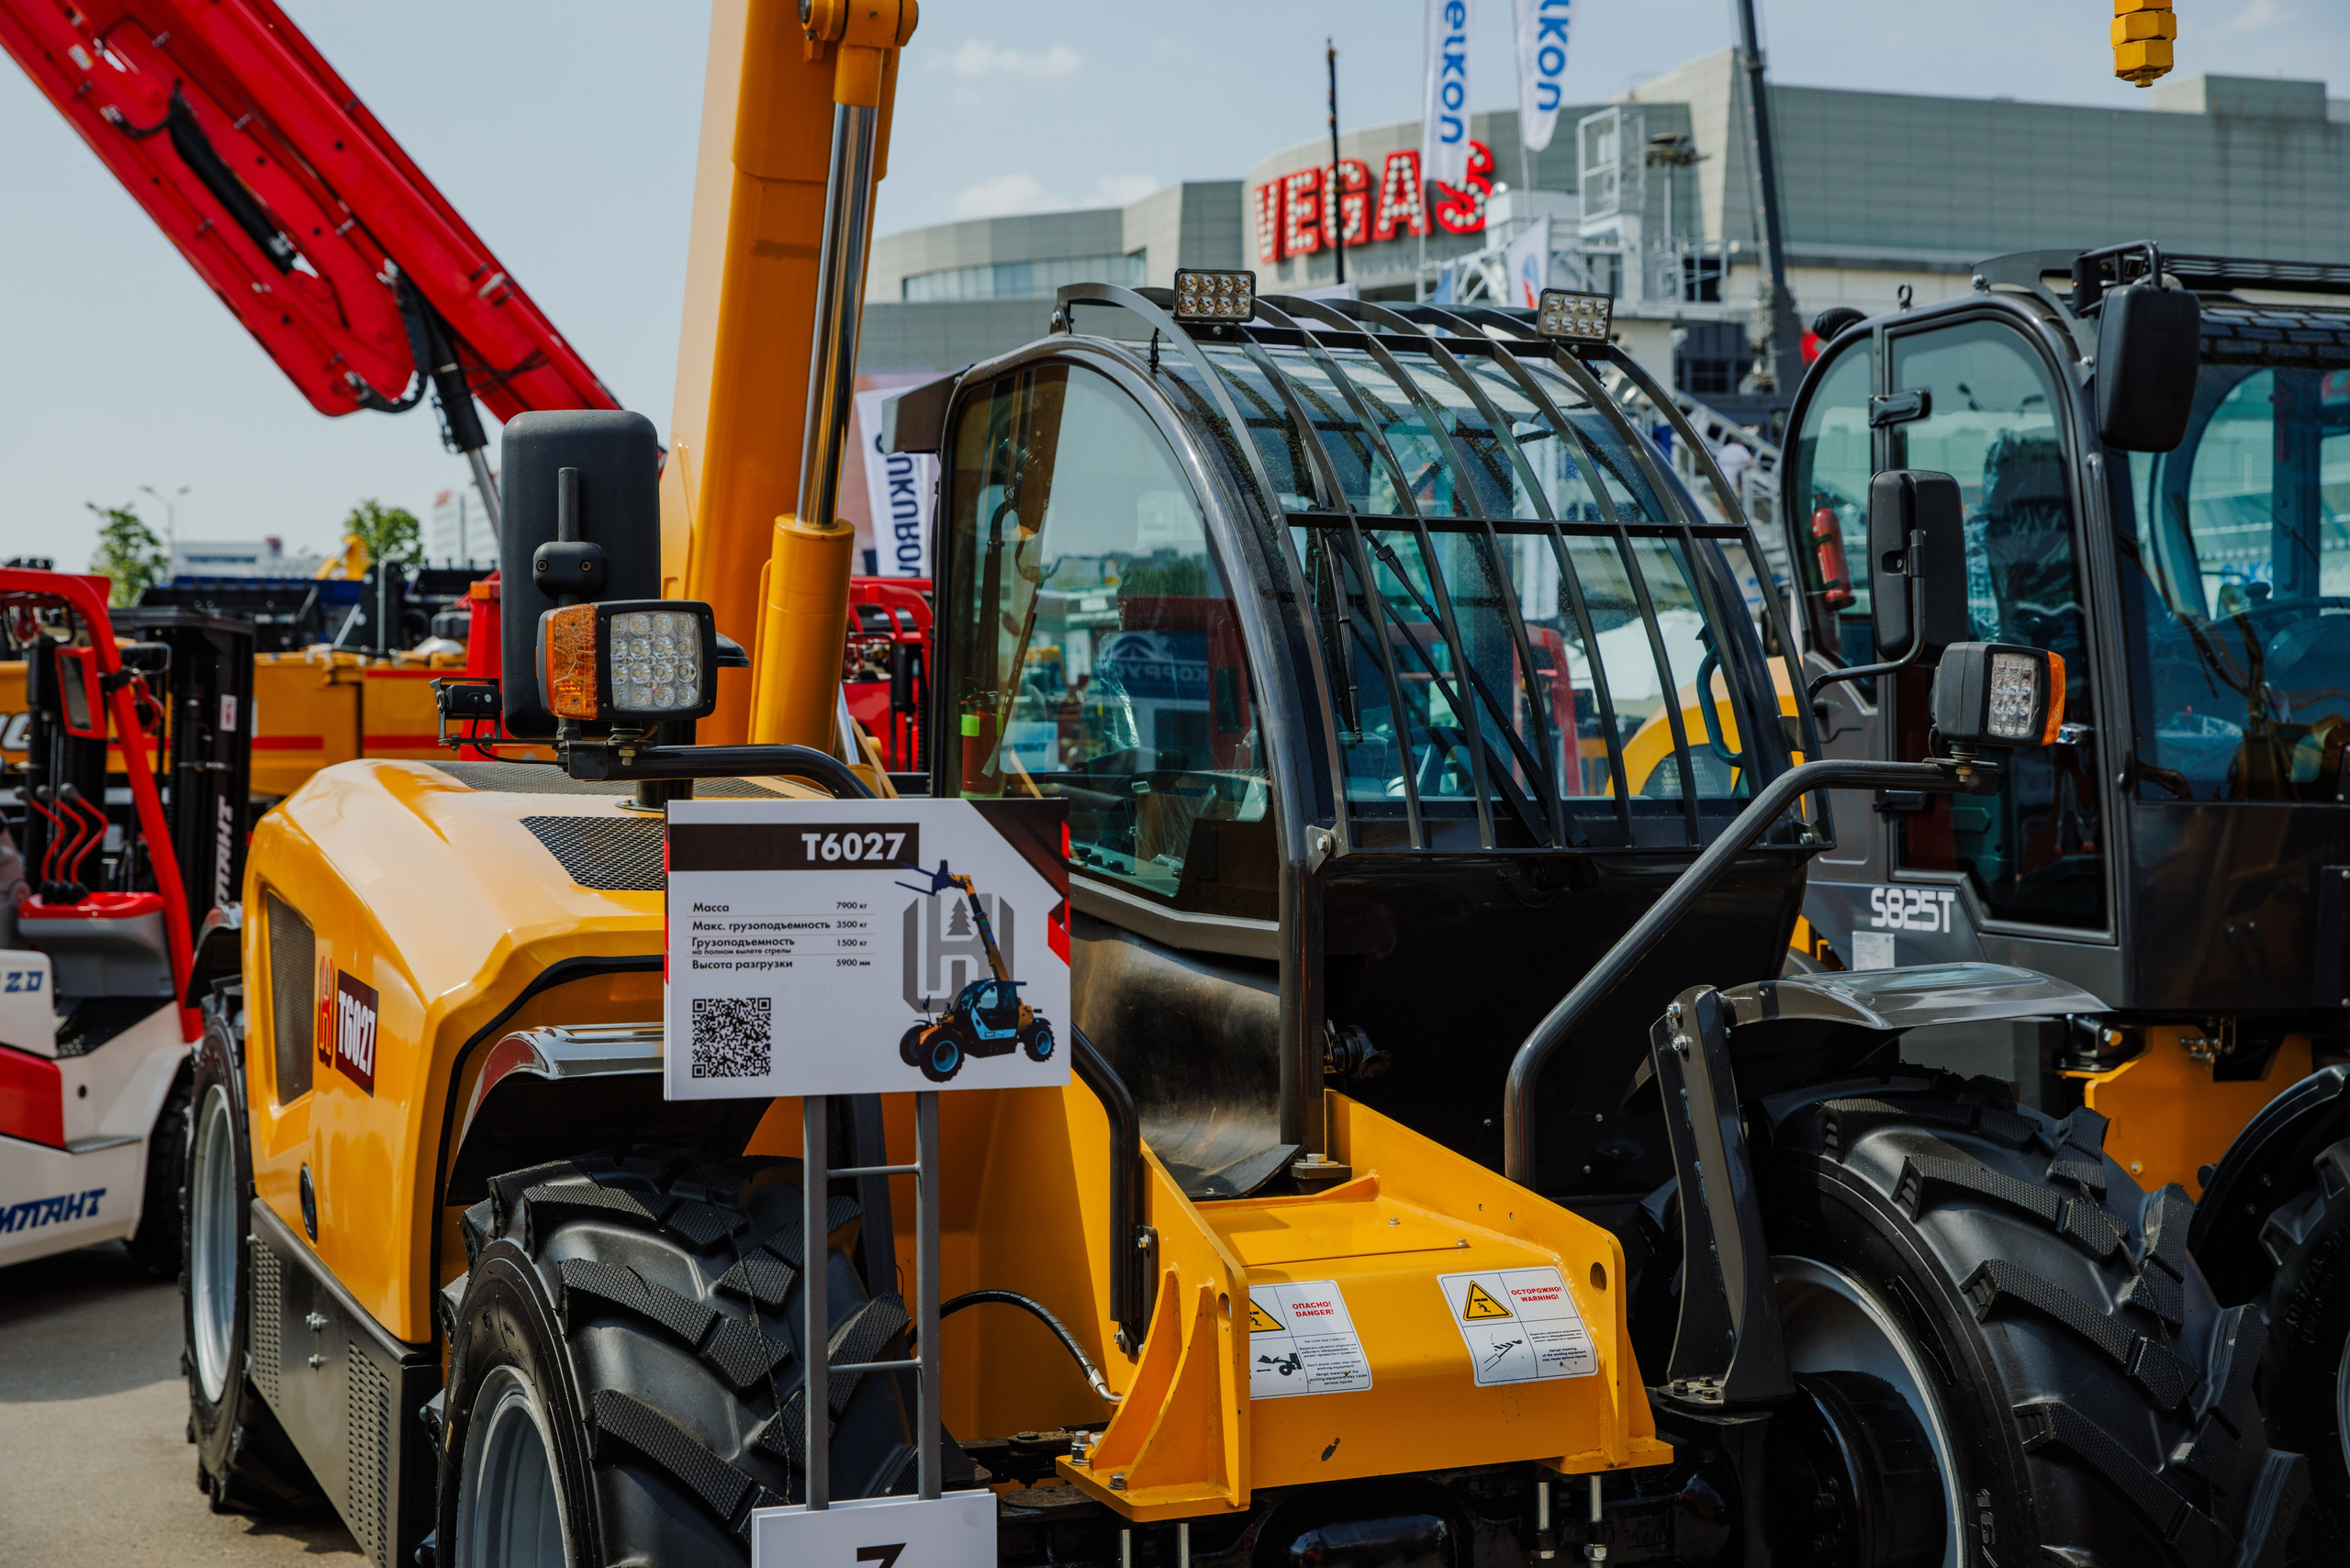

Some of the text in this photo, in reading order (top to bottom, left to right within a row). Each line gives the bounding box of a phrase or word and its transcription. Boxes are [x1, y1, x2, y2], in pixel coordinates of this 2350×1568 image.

[1254, 140, 1493, 263] VEGAS
[801, 832, 907, 861] T6027
[693, 902, 730, 913] Масса
[836, 902, 857, 910] 7900
[1870, 887, 1955, 934] S825T
[692, 921, 726, 931] Макс.
[729, 921, 831, 933] грузоподъемность
[692, 937, 795, 949] Грузоподъемность
[692, 960, 733, 969] Высота
[735, 960, 793, 971] разгрузки
[338, 989, 376, 1077] T6027
[1511, 1286, 1562, 1295] ОСТОРОЖНО!
[1520, 1294, 1560, 1302] WARNING!
[1292, 1301, 1332, 1310] ОПАСНО!
[1295, 1309, 1335, 1317] DANGER!
